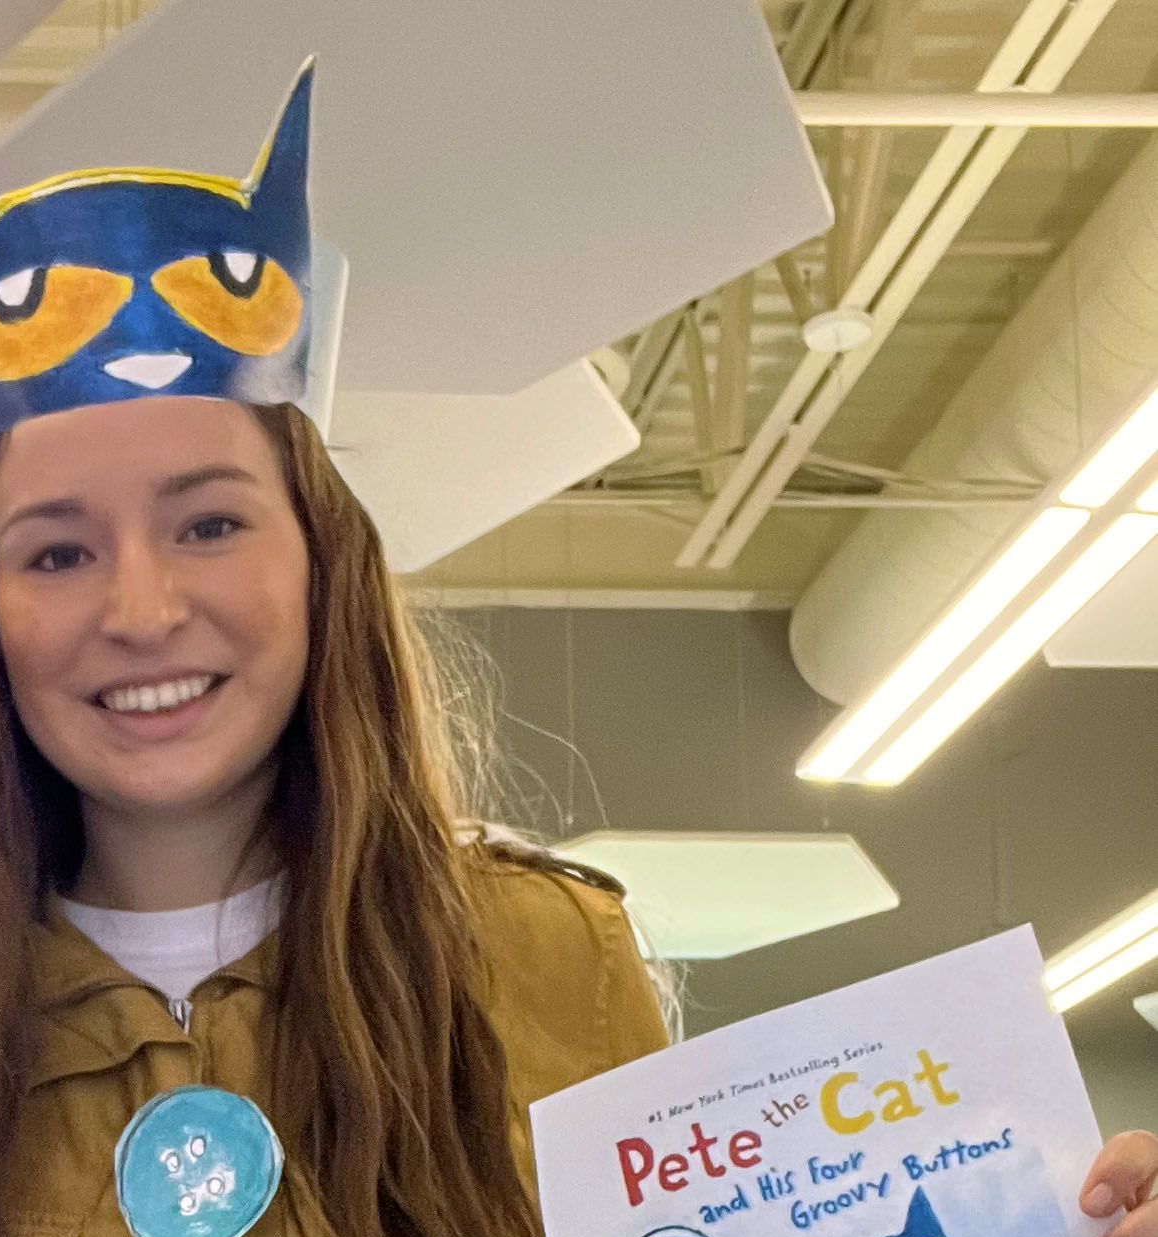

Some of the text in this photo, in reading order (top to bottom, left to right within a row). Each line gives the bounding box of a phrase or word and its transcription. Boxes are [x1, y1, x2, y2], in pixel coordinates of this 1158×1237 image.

[669, 1101, 695, 1118] New
[698, 1090, 725, 1107] York
[730, 1079, 765, 1097] Times
[769, 1055, 840, 1084] Bestselling
[843, 1042, 883, 1062] Series
[616, 1048, 961, 1207] Pete the Cat
[699, 1151, 864, 1224] and His Four
[791, 1127, 1012, 1230] Groovy Buttons
